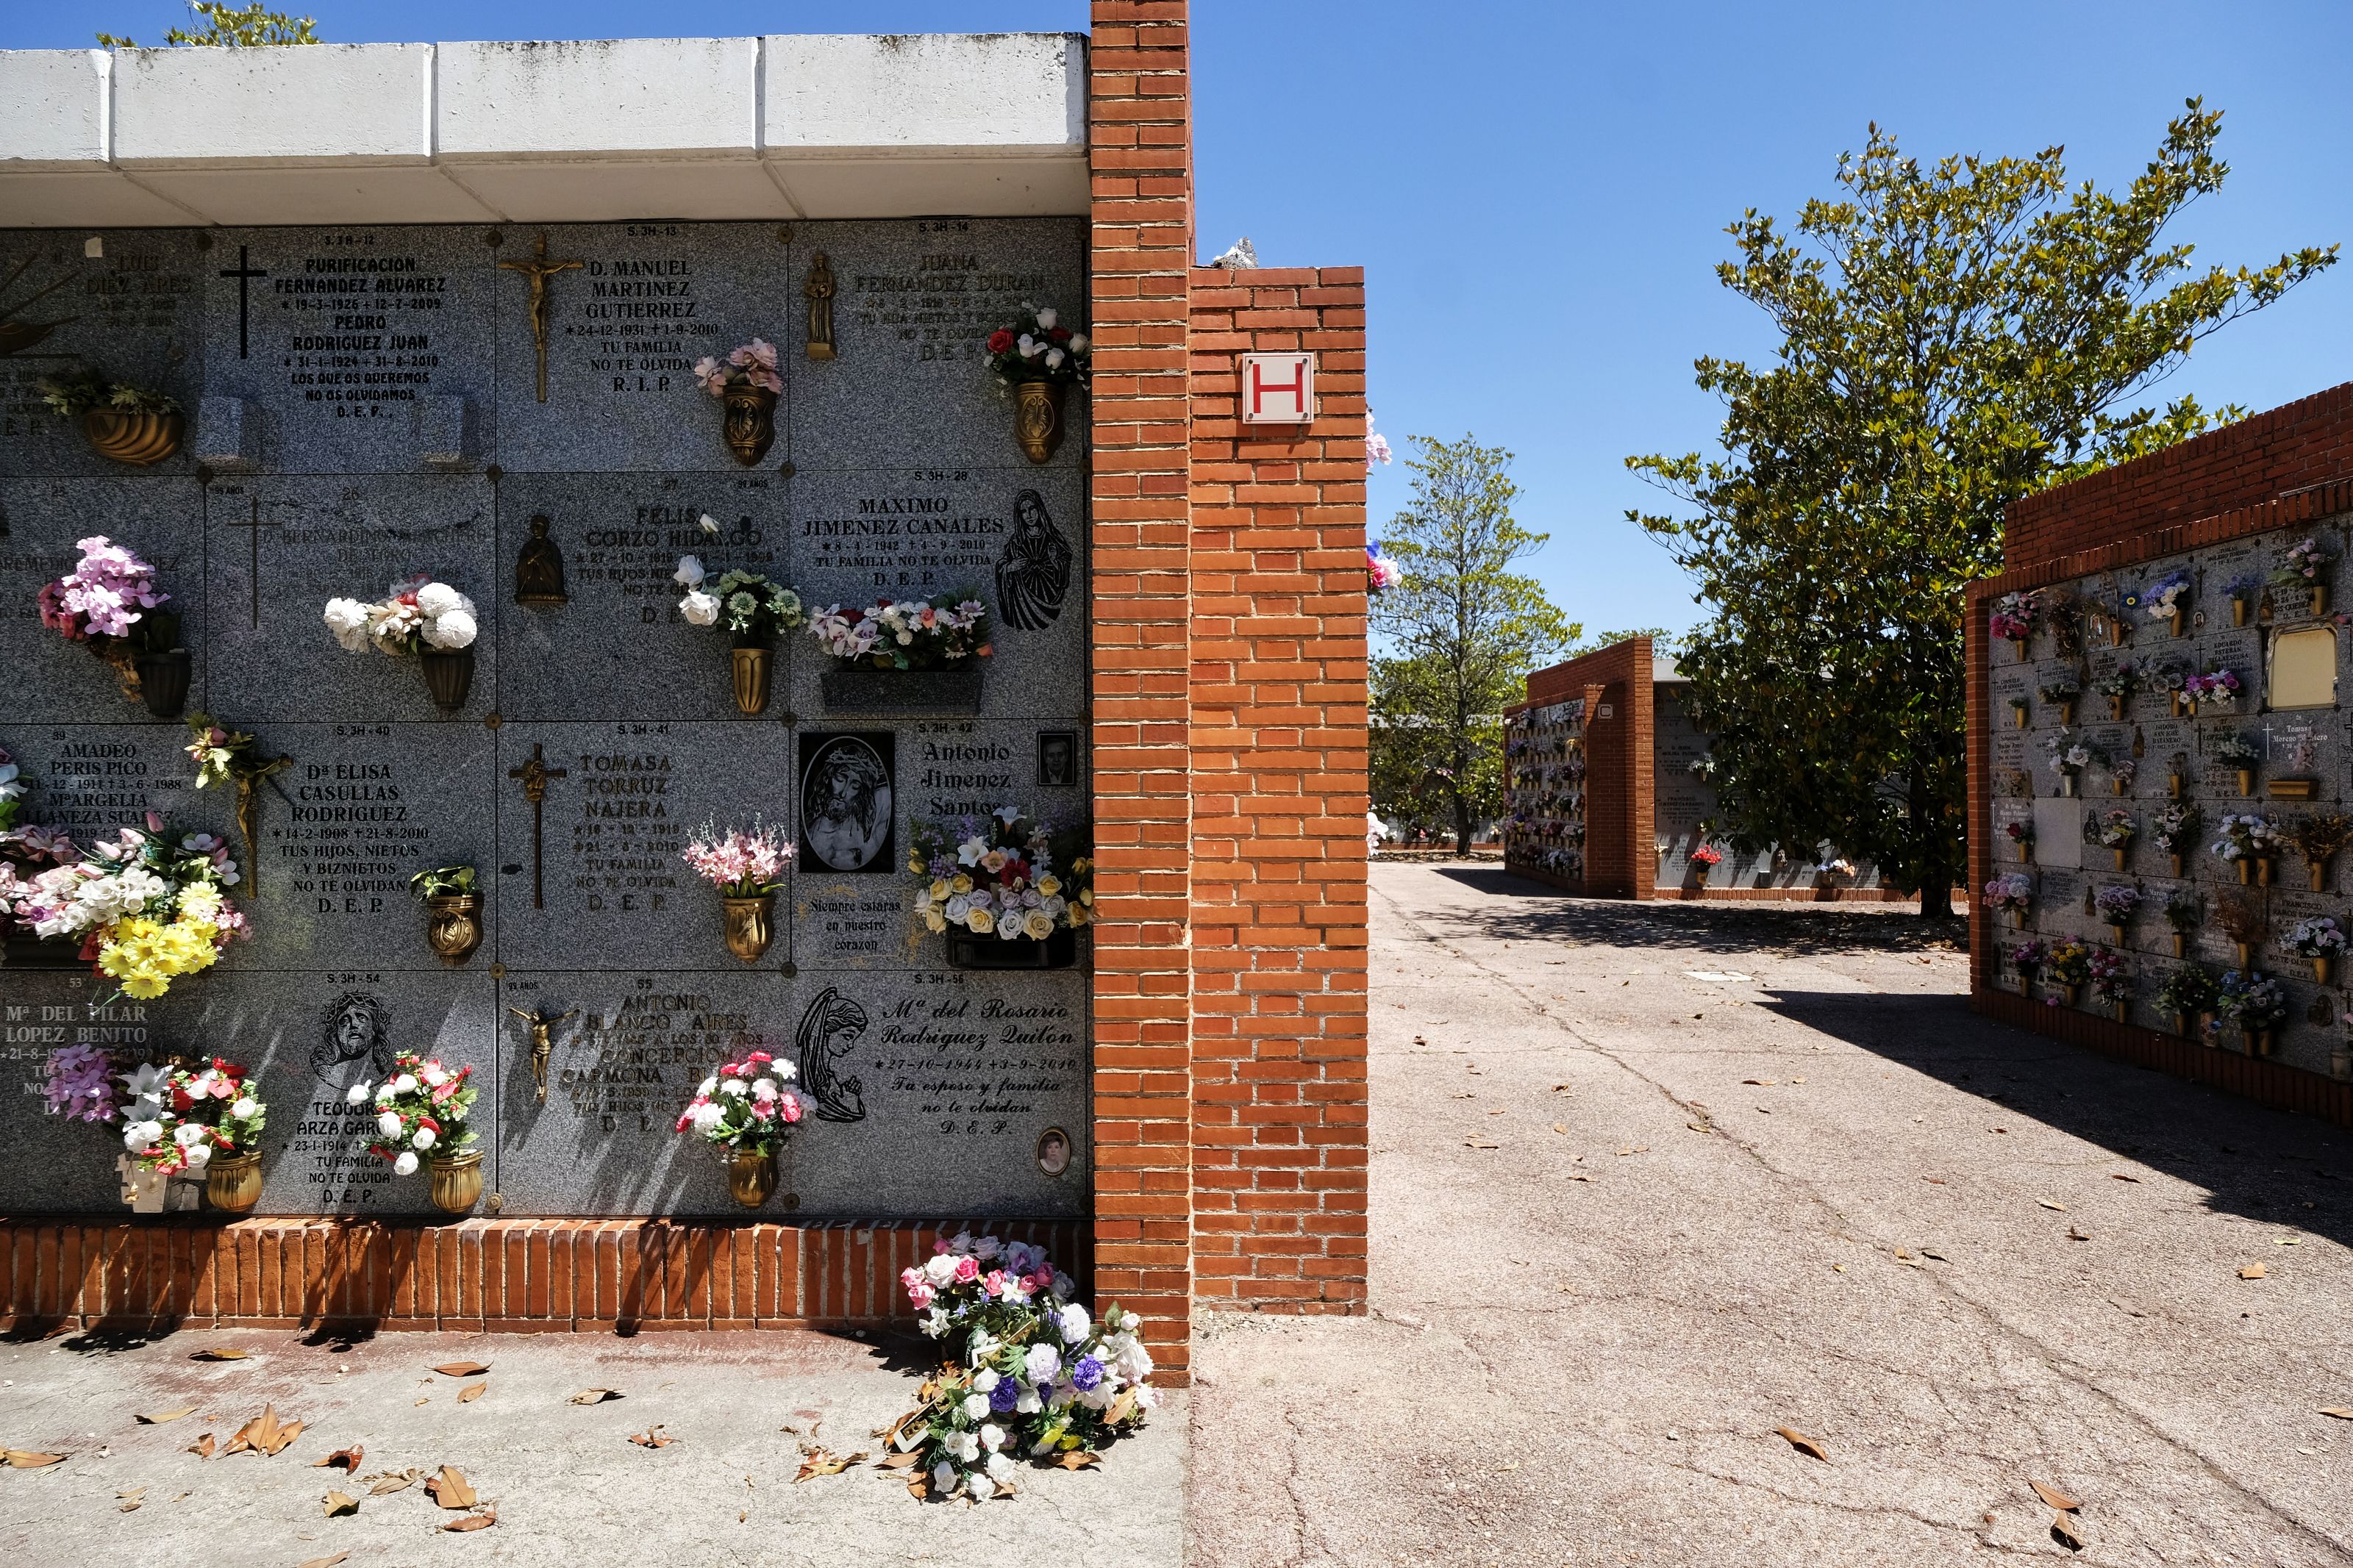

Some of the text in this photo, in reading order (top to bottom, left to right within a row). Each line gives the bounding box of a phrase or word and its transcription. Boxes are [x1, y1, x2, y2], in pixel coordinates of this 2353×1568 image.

[306, 258, 415, 273] PURIFICACION
[590, 261, 692, 276] D. MANUEL
[920, 256, 979, 271] JUANA
[276, 278, 446, 293] FERNANDEZ ALVAREZ
[592, 282, 690, 297] MARTINEZ
[855, 275, 1043, 293] FERNANDEZ DURAN
[296, 298, 440, 309] 19-3-1926 12-7-2009
[586, 303, 696, 318] GUTIERREZ
[335, 315, 386, 329] PEDRO
[915, 312, 960, 323] NIETOS
[578, 324, 718, 336] 24-12-1931 1-9-2010
[293, 335, 428, 350] RODRIGUEZ JUAN
[601, 342, 681, 353] TU FAMILIA
[299, 356, 438, 368] 31-1-1924 31-8-2010
[590, 359, 692, 370] NO TE OLVIDA
[292, 373, 429, 384] LOS QUE OS QUEREMOS
[613, 377, 670, 392] R. I. P.
[1253, 362, 1303, 413] H
[306, 390, 415, 401] NO OS OLVIDAMOS
[342, 487, 359, 501] 26
[860, 498, 948, 514] MAXIMO
[803, 518, 1004, 536] JIMENEZ CANALES
[588, 529, 762, 547] CORZO HIDALGO
[816, 555, 990, 567] TU FAMILIA NO TE OLVIDA
[2215, 640, 2241, 648] EDUARDO
[2215, 647, 2240, 655] ESTEBAN
[1600, 706, 1610, 717] C
[351, 726, 390, 735] 3H 40
[632, 726, 668, 734] 3H 41
[61, 745, 136, 758] AMADEO
[922, 742, 1010, 763] Antonio
[51, 762, 147, 775] PERIS PICO
[580, 755, 671, 771] TOMASA
[307, 765, 391, 779] Dª ELISA
[154, 780, 181, 789] 1988
[585, 778, 667, 794] TORRUZ
[921, 770, 1011, 792] Jimenez
[299, 786, 399, 801] CASULLAS
[292, 807, 407, 822] RODRIGUEZ
[586, 801, 666, 817] NAJERA
[25, 812, 102, 824] LLANEZA
[286, 828, 428, 839] 14-2-1908 21-8-2010
[280, 845, 418, 859] TUS HIJOS, NIETOS
[303, 863, 396, 874] Y BIZNIETOS
[588, 859, 665, 870] TU FAMILIA
[294, 881, 405, 892] NO TE OLVIDAN
[577, 876, 676, 888] NO OLVIDA
[318, 898, 382, 912] D. E. P.
[810, 900, 901, 914] Siempre estaras
[2282, 900, 2322, 910] FRANCISCO
[826, 920, 885, 932] en nuestro
[835, 940, 877, 951] corazon
[70, 978, 82, 987] 53
[341, 974, 379, 983] 3H 54
[638, 979, 652, 989] 55
[624, 995, 711, 1011] ANTONIO
[883, 999, 1068, 1018] Mª del Rosario
[6, 1006, 148, 1022] Mª DEL PILAR
[588, 1014, 747, 1030] BLANCO AIRES
[6, 1027, 147, 1042] LOPEZ BENITO
[881, 1025, 988, 1051] Rodriguez
[601, 1048, 735, 1064] CONCEPCION
[888, 1059, 982, 1070] 27-10-1944
[563, 1067, 663, 1083] CARMONA
[891, 1076, 1060, 1096] Tu esposo y familia
[313, 1102, 374, 1116] TEODOR
[922, 1104, 940, 1113] no
[970, 1100, 1030, 1113] olvidan
[297, 1122, 338, 1135] ARZA
[295, 1141, 346, 1151] 23-1-1914
[316, 1157, 382, 1167] TU FAMILIA
[310, 1173, 390, 1184] NO TE OLVIDA
